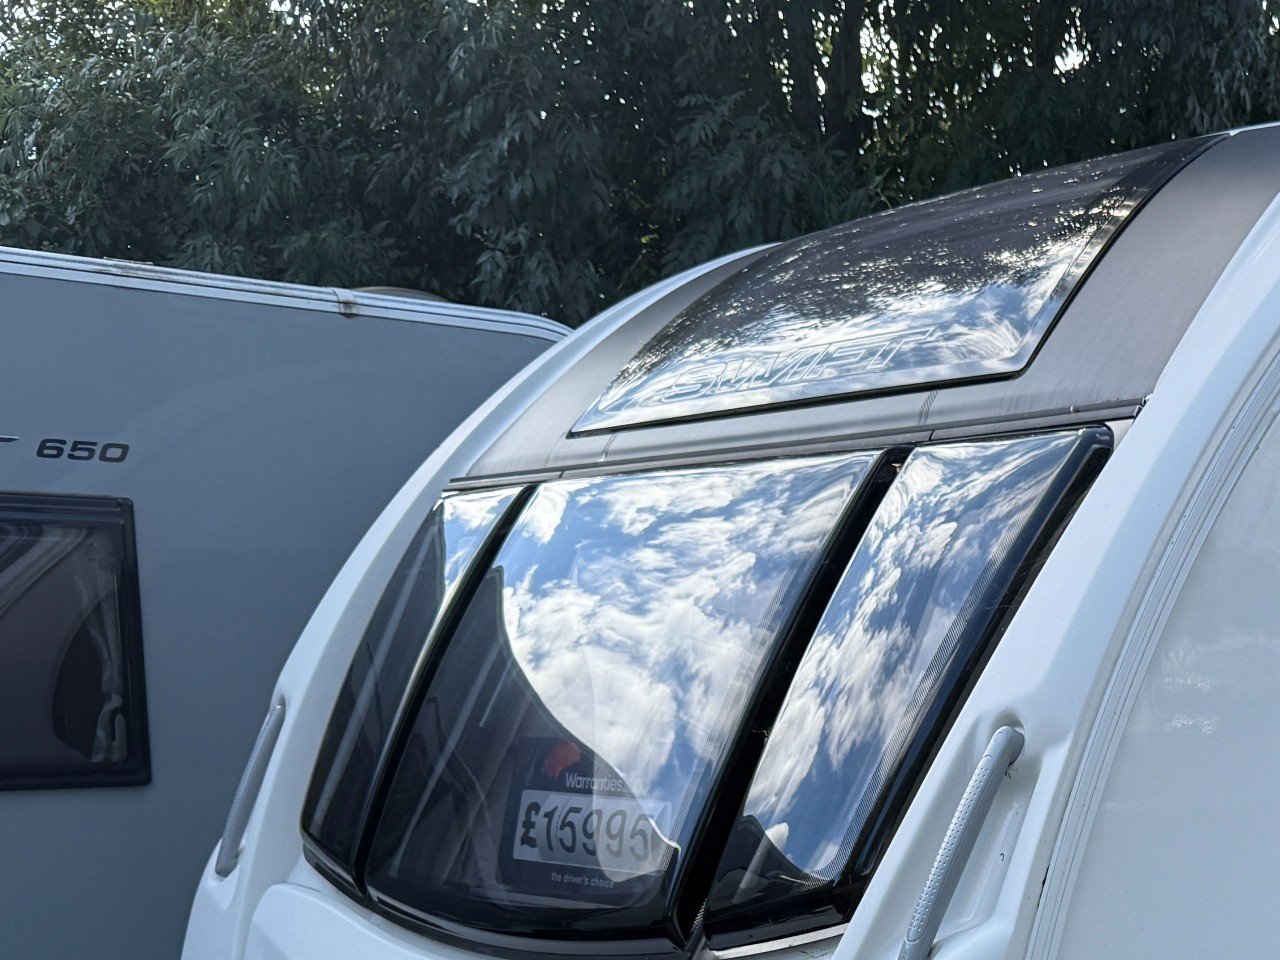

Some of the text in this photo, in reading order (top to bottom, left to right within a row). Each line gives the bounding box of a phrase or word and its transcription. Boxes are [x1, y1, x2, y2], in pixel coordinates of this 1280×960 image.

[660, 327, 937, 402] SWIFT
[36, 438, 130, 463] 650
[520, 801, 654, 862] £15995
[551, 872, 615, 889] the driver's choice
